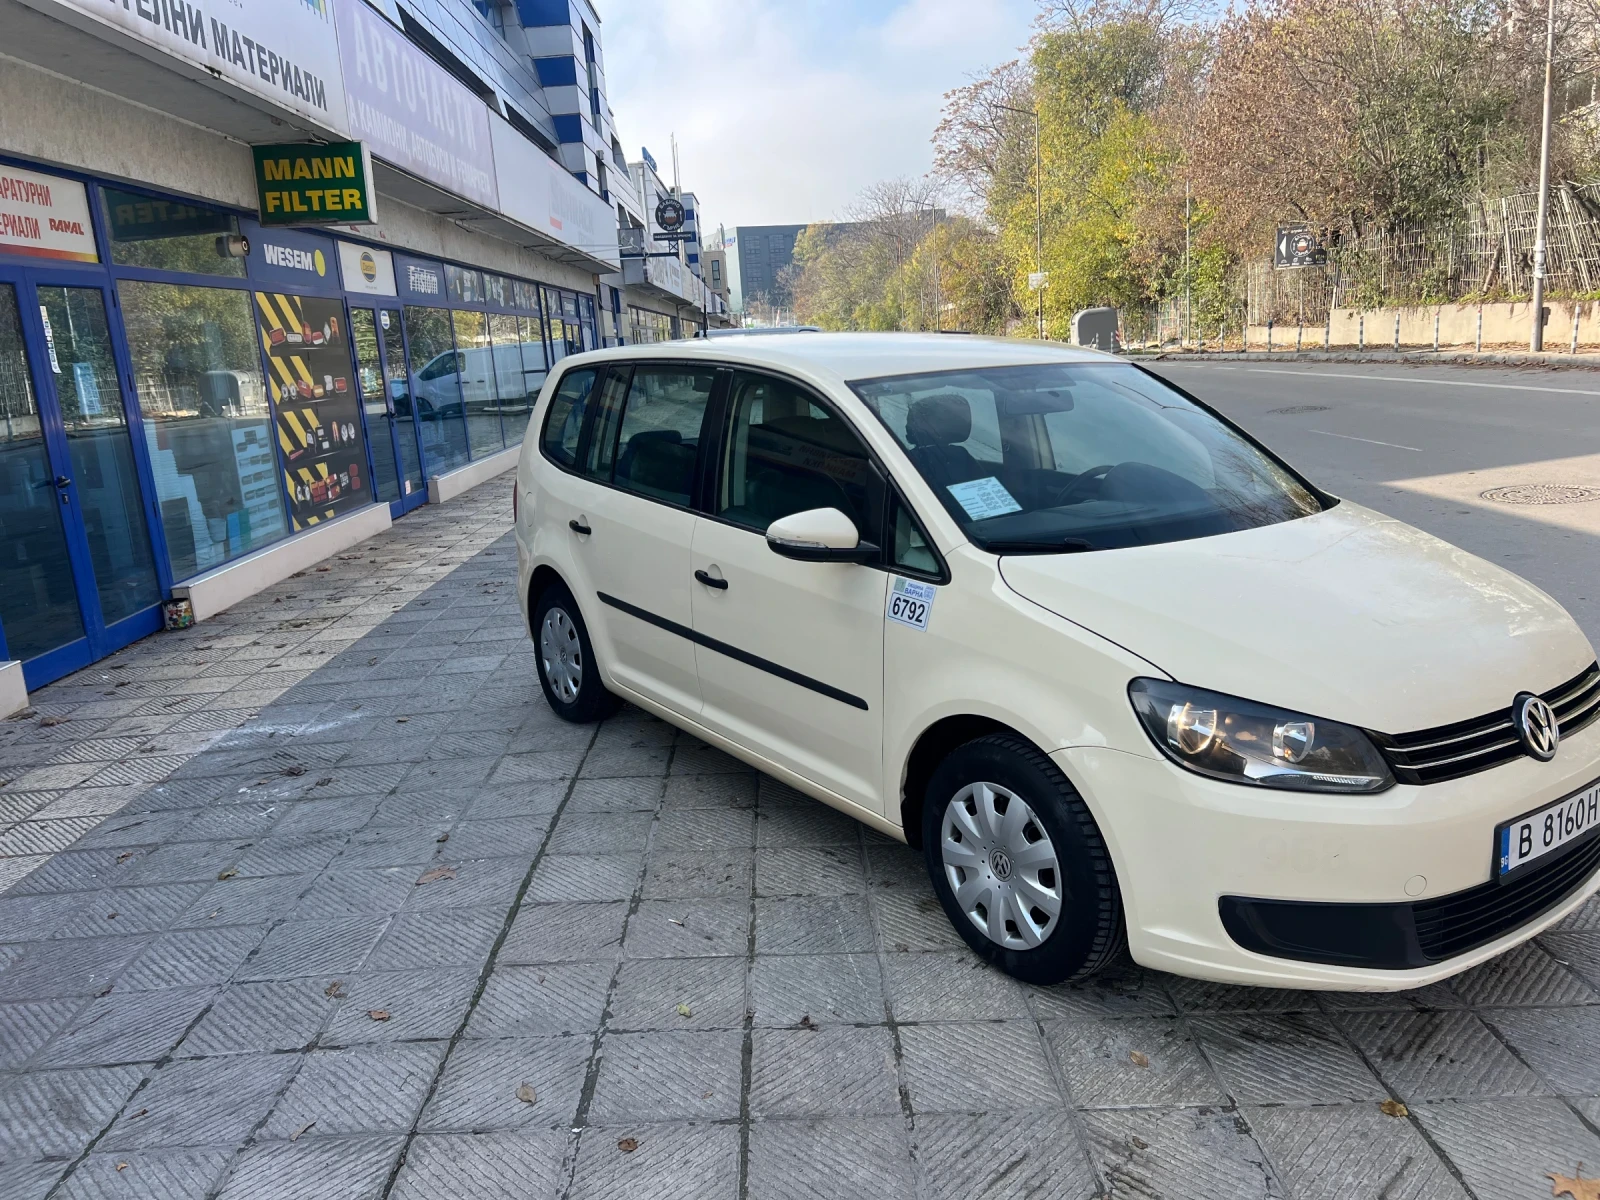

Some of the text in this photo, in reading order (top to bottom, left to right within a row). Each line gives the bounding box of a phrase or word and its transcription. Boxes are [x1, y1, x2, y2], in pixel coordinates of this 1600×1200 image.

[211, 16, 328, 112] МАТЕРИАЛИ
[353, 11, 478, 151] АВТОЧАСТИ
[263, 156, 355, 181] MANN
[265, 188, 363, 213] FILTER
[263, 243, 313, 272] WESEM
[904, 587, 923, 599] ВАРНА
[892, 596, 926, 624] 6792
[1518, 823, 1533, 860] B
